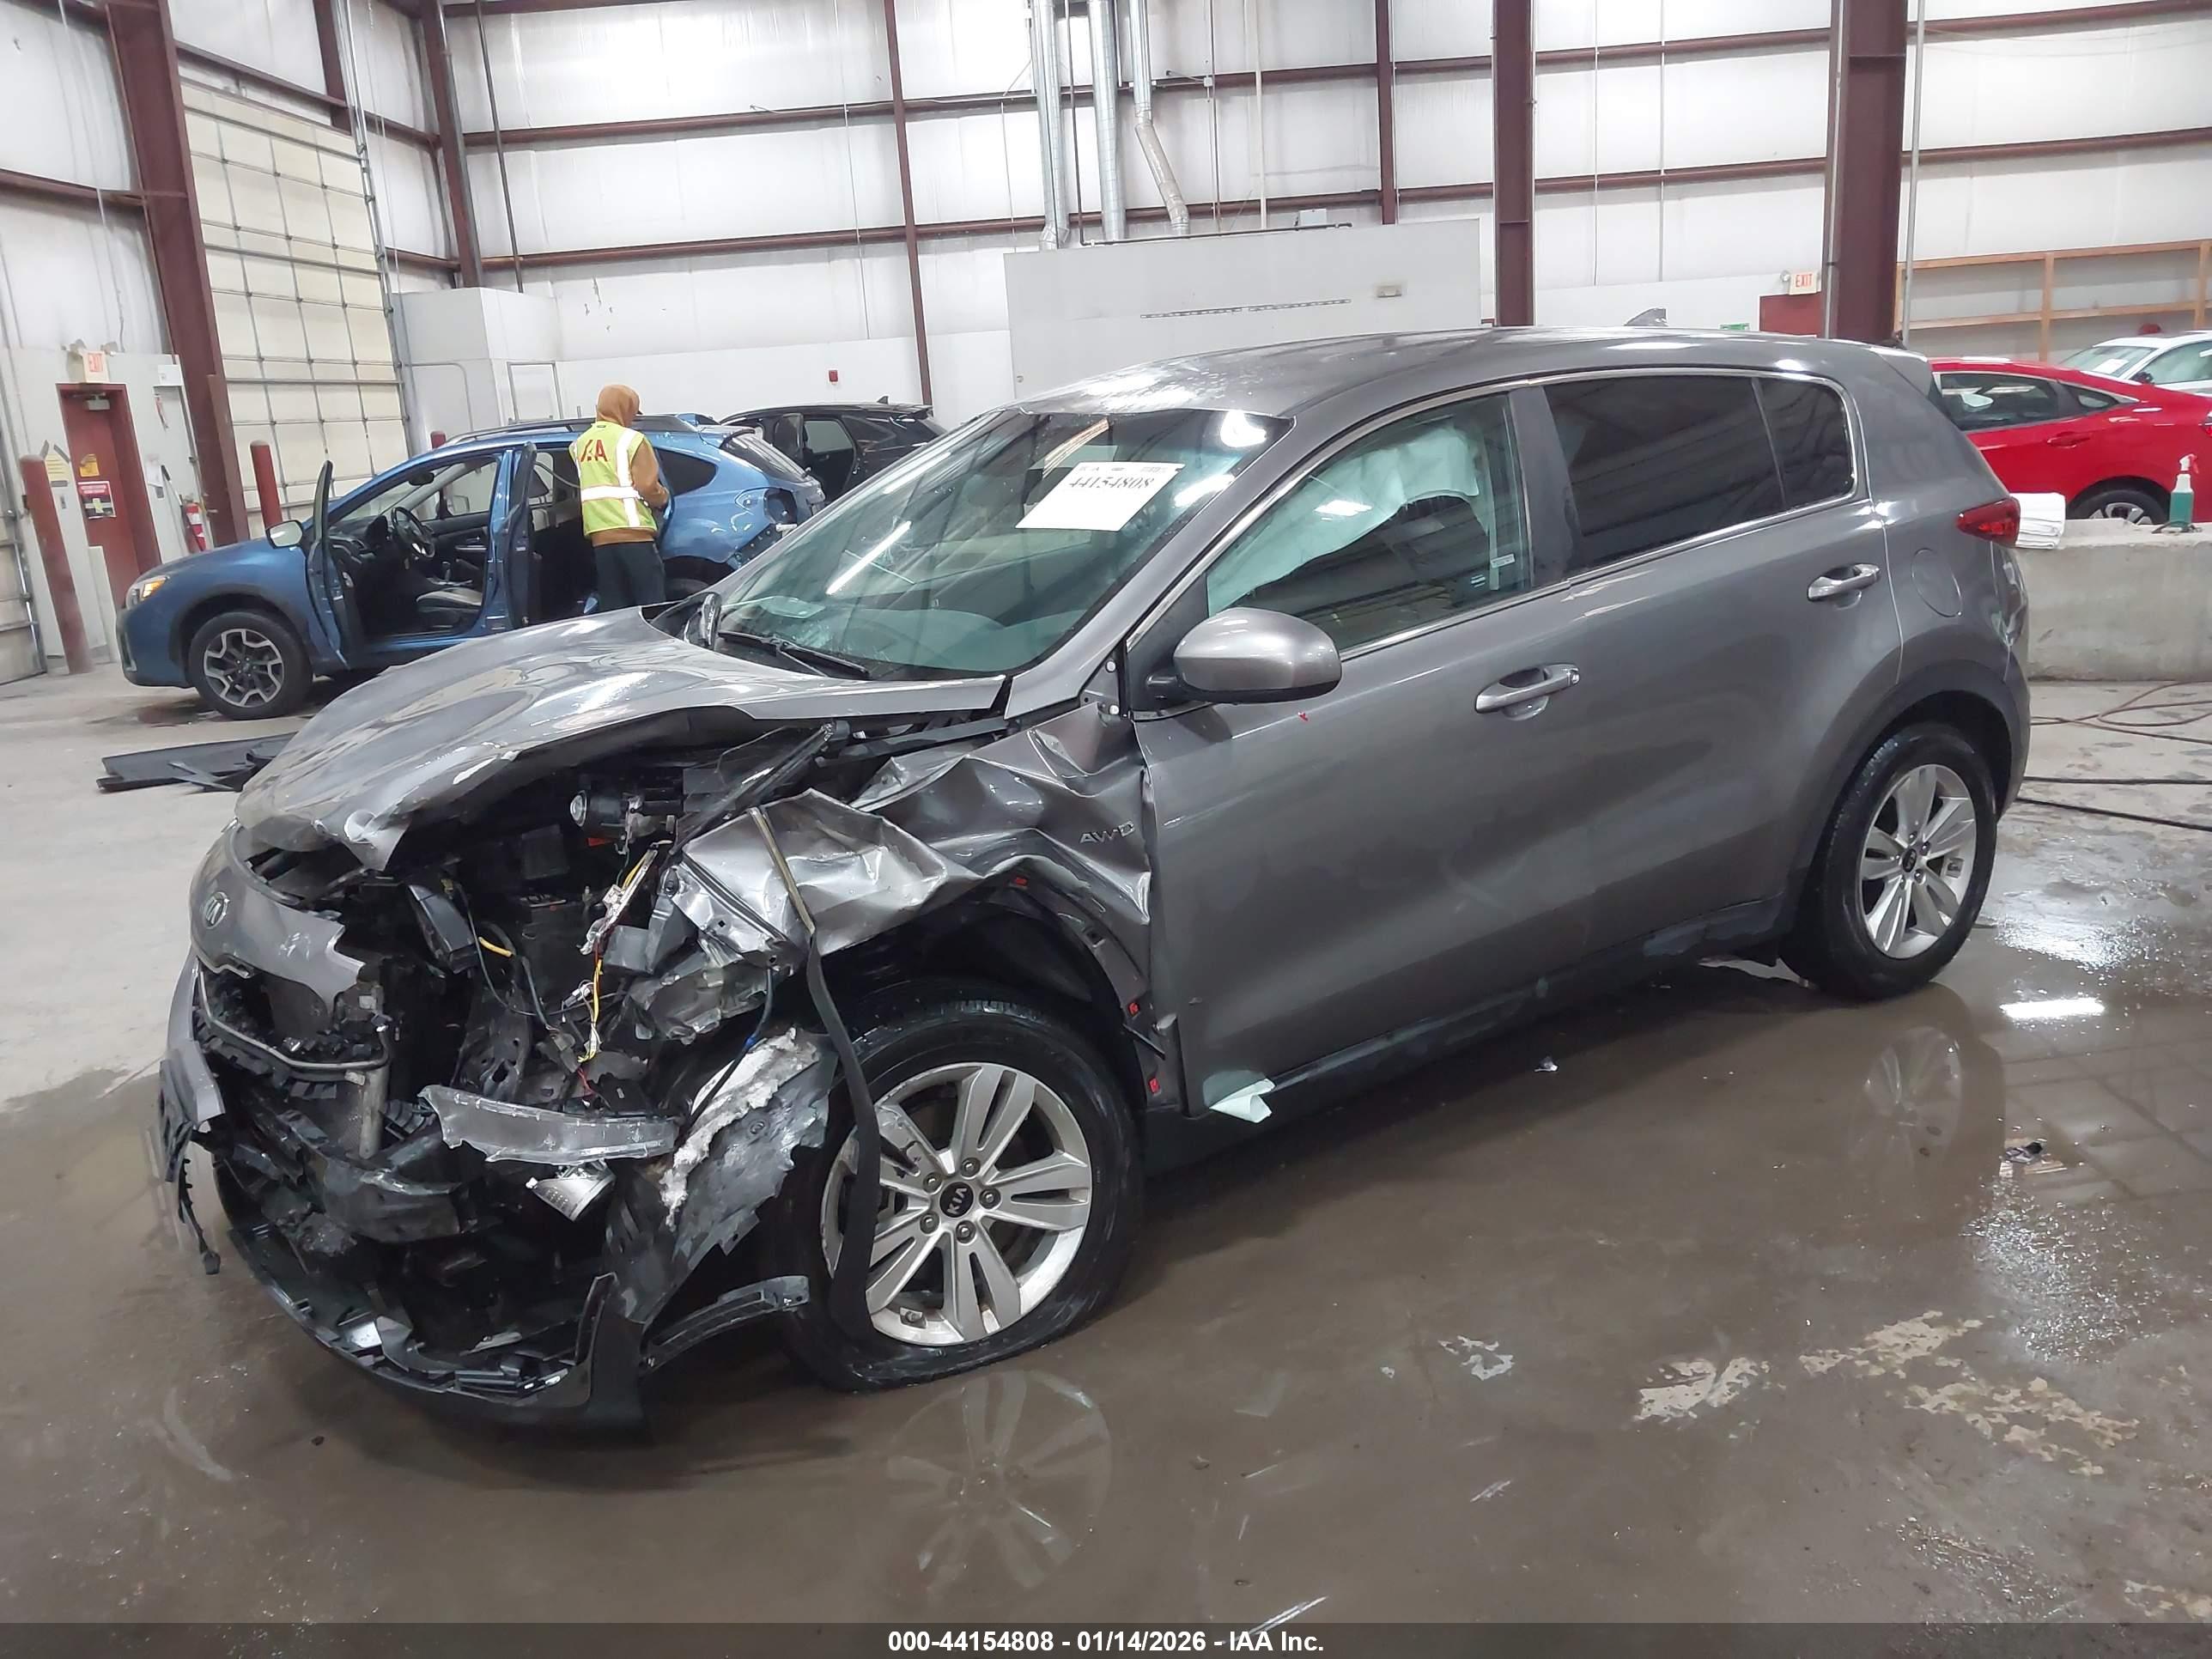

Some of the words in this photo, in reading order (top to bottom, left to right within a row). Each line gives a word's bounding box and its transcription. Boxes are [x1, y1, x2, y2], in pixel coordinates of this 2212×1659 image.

[1795, 273, 1813, 288] EXIT
[1069, 477, 1155, 489] 44154808
[1079, 821, 1134, 843] AWD
[946, 1188, 968, 1215] KIA
